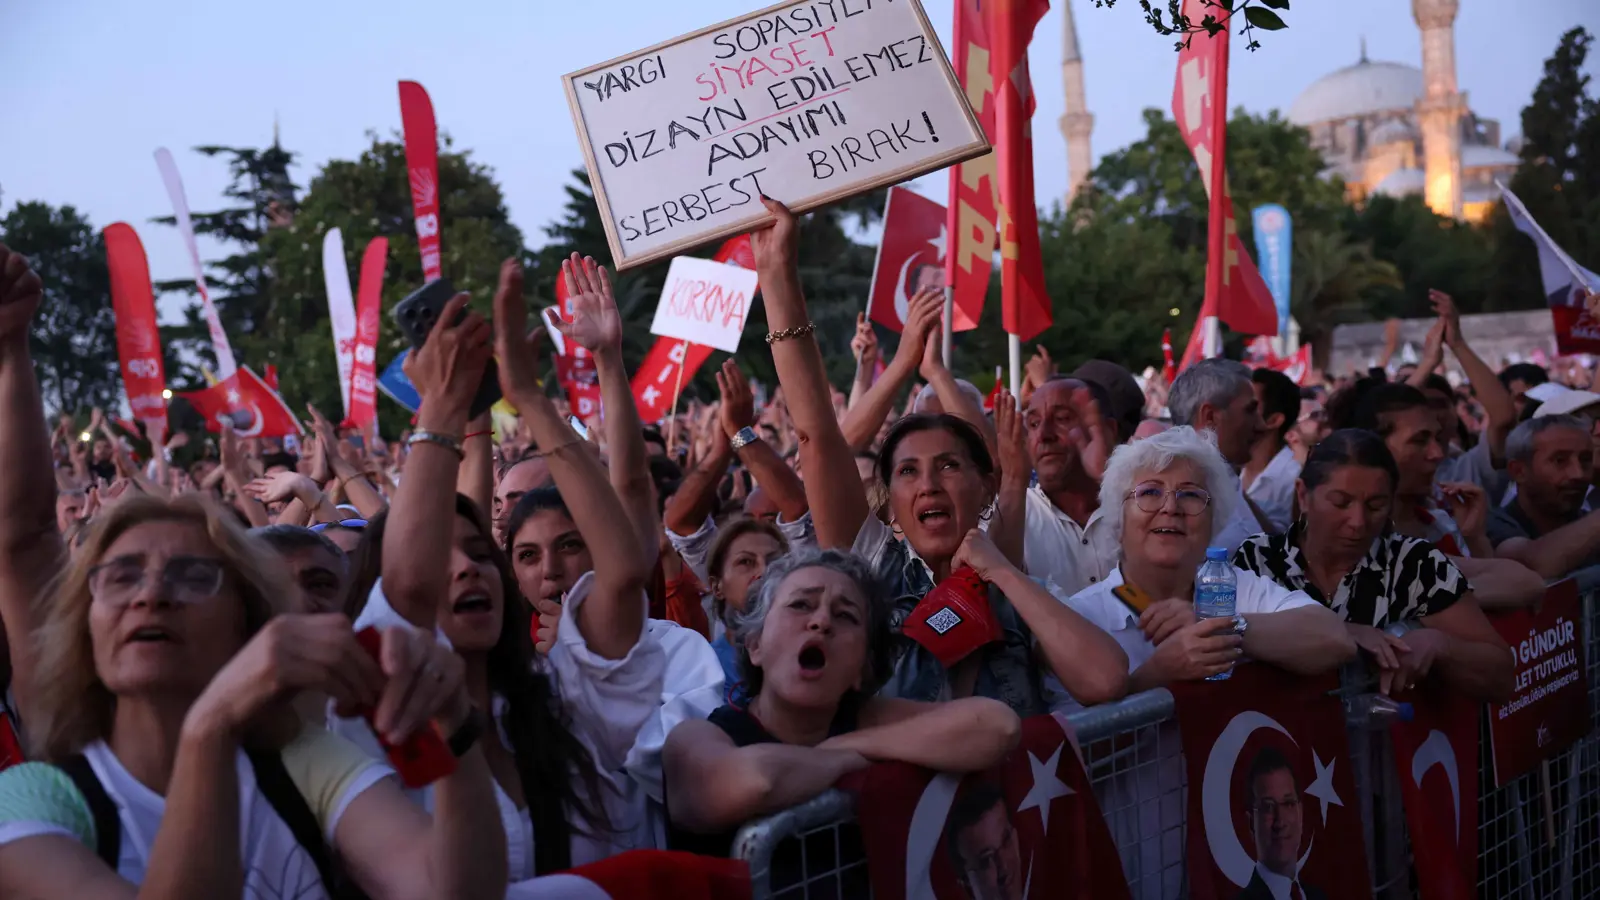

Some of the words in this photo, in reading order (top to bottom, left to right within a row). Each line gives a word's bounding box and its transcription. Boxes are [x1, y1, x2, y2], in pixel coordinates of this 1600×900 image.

[584, 55, 667, 102] YARGI
[714, 0, 893, 60] SOPASIYL
[695, 26, 836, 102] SİYASET
[604, 98, 747, 168] DİZAYN
[768, 35, 933, 110] EDİLEMEZ
[708, 101, 847, 176] ADAYIMI
[620, 167, 768, 242] SERBEST
[666, 277, 746, 333] KORKMA
[1520, 617, 1574, 663] GÜNDÜR
[1515, 667, 1533, 692] LET
